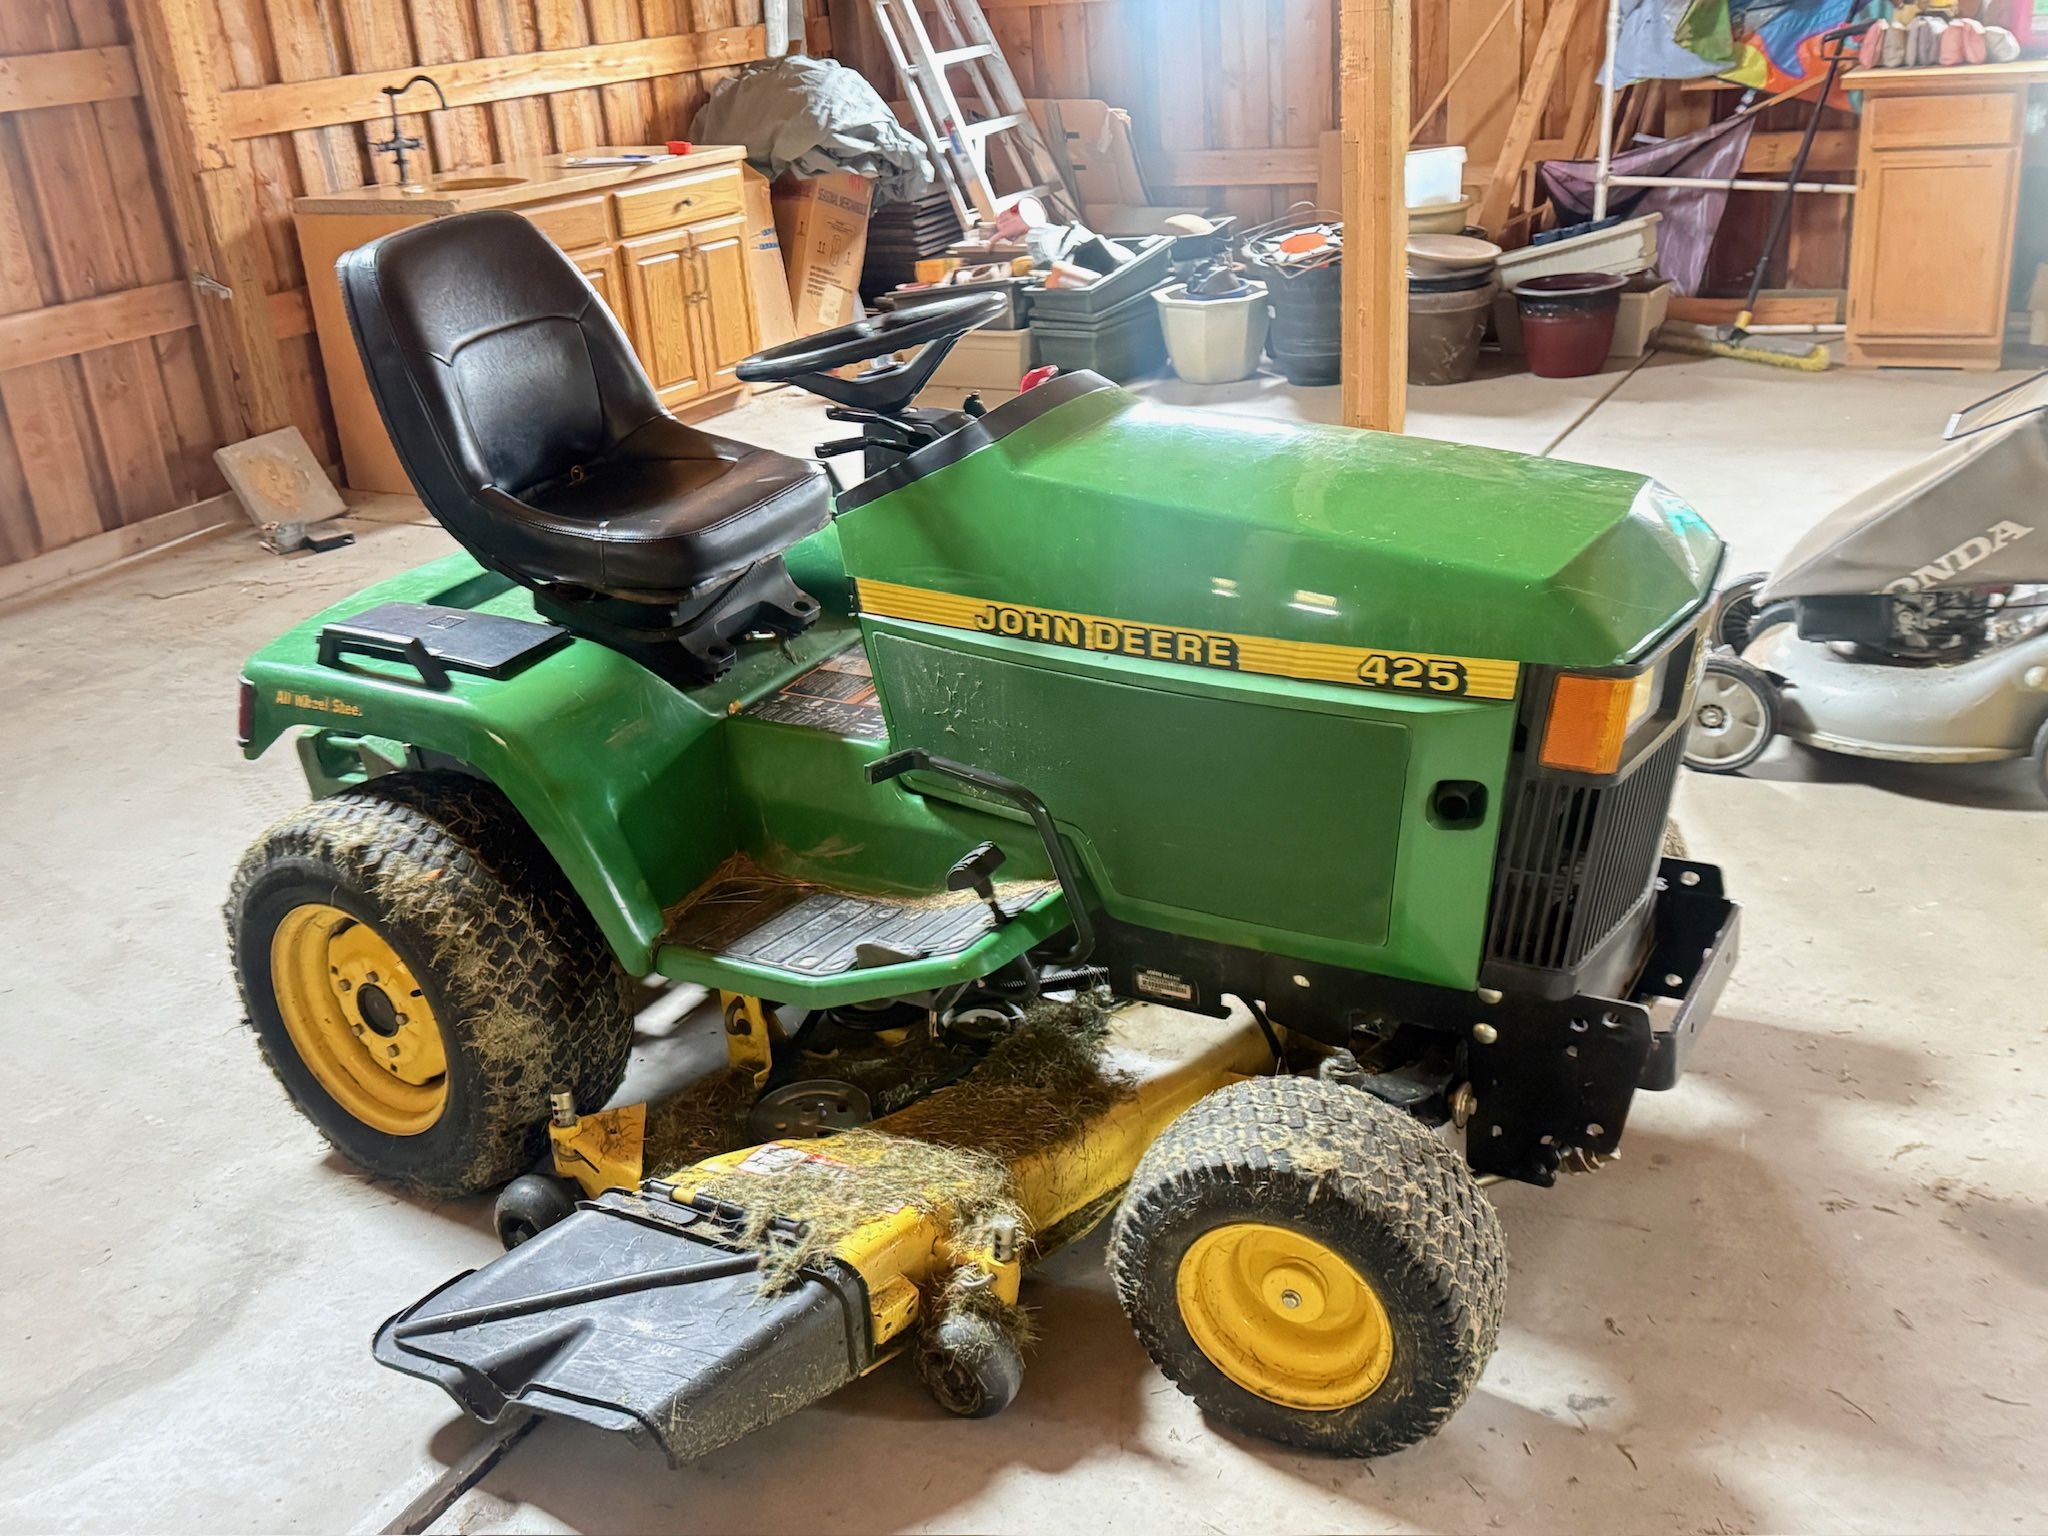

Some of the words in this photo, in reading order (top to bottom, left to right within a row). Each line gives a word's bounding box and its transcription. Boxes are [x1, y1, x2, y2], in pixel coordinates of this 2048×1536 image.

[1872, 520, 2035, 595] ONDA
[975, 606, 1084, 648] JOHN
[1093, 621, 1238, 670] DEERE
[1359, 655, 1466, 694] 425
